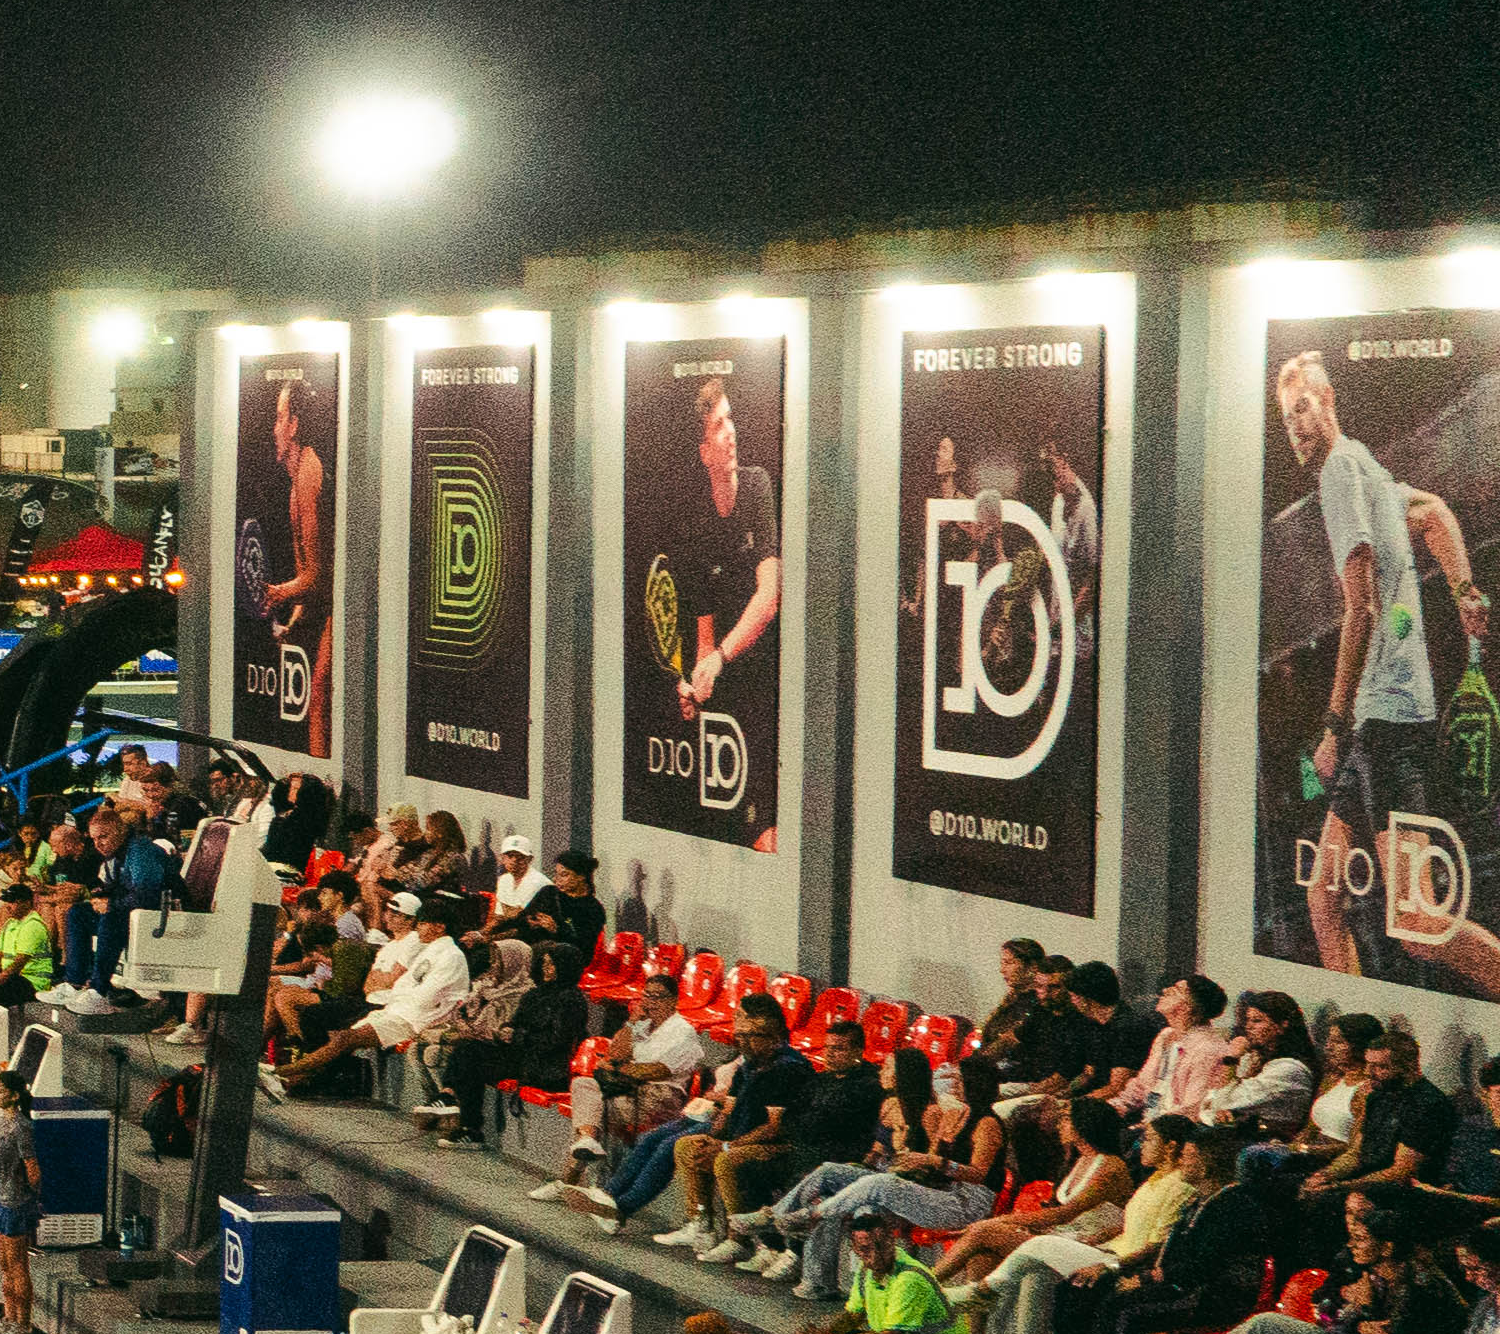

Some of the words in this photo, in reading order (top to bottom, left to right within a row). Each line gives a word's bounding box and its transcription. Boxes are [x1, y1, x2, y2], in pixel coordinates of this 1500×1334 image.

[912, 344, 996, 373] FOREVER
[1003, 340, 1084, 369] STRONG
[421, 368, 470, 386] FOREVER
[473, 366, 519, 385] STRONG
[929, 809, 1049, 851] @D10.WORLD
